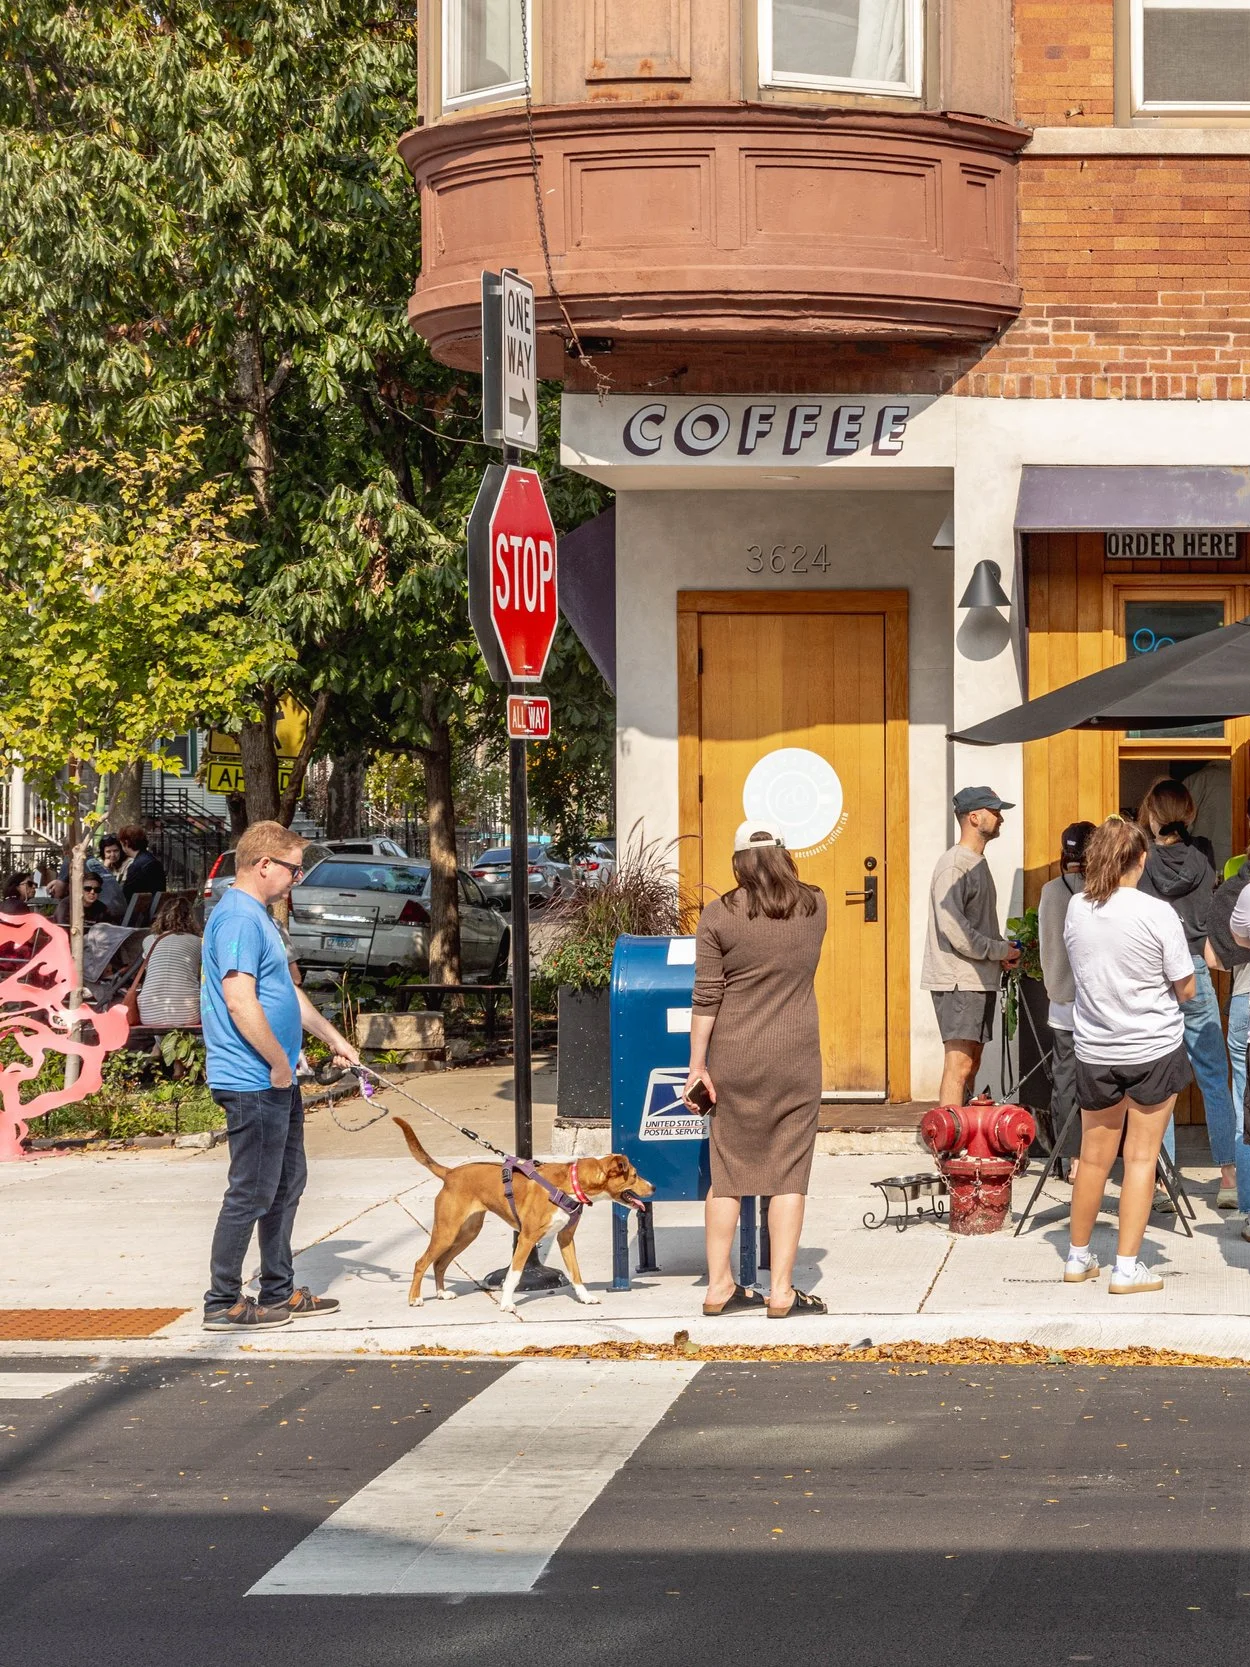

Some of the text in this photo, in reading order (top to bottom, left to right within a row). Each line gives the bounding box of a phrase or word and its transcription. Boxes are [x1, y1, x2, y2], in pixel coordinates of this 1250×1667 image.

[507, 289, 531, 335] ONE
[507, 335, 532, 380] WAY
[622, 402, 909, 457] COFFEE
[745, 543, 832, 574] 3624
[1107, 532, 1235, 557] ORDER HERE
[495, 532, 554, 613] STOP
[512, 705, 546, 729] ALL WAY
[217, 768, 292, 791] AHD
[645, 1119, 705, 1128] UNITED STATES
[674, 1127, 707, 1136] SERVICE
